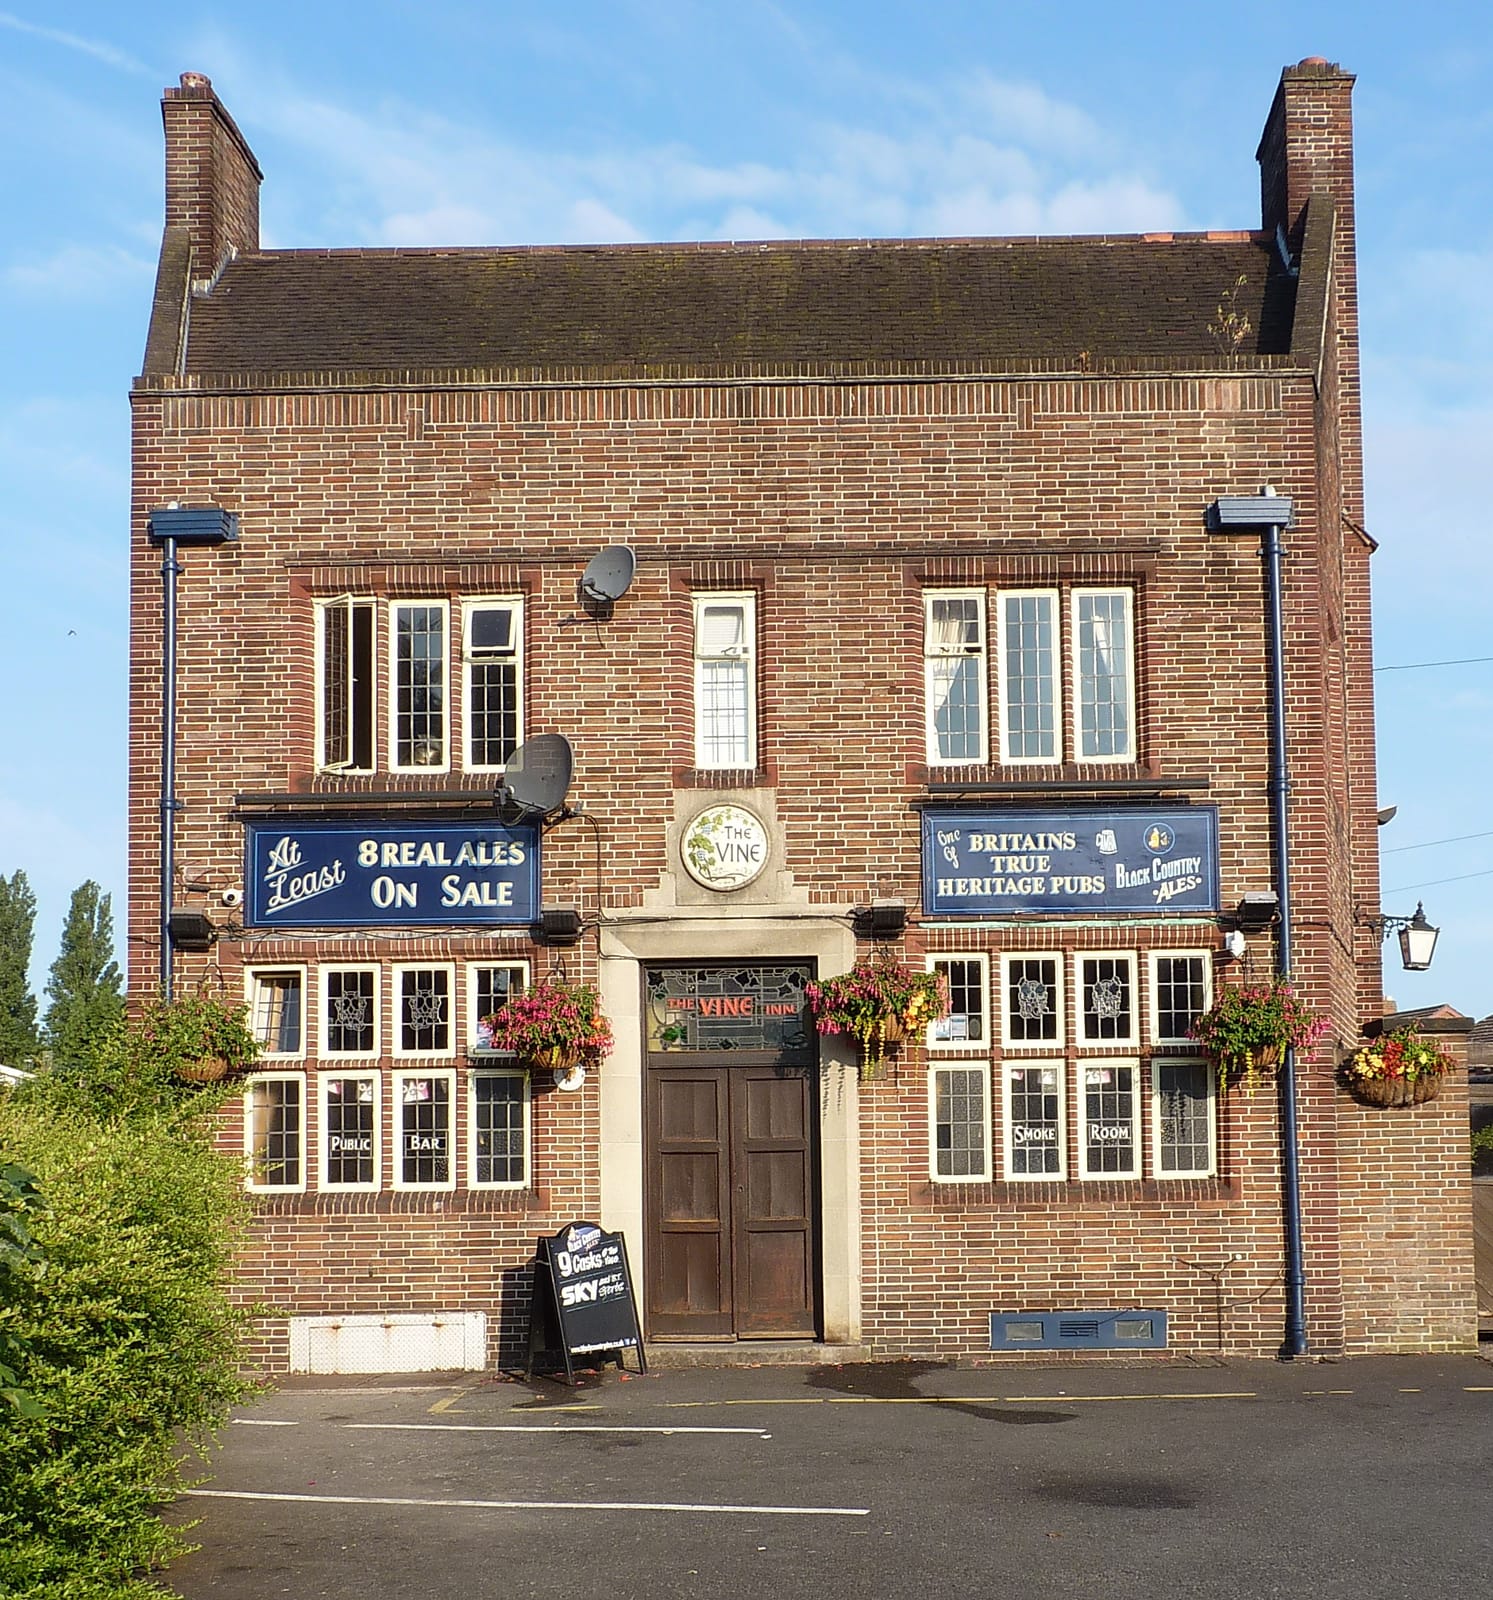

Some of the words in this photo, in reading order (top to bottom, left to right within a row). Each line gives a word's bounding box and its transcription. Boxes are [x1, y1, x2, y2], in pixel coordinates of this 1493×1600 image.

[723, 825, 752, 839] THE
[937, 829, 961, 847] One
[267, 836, 302, 873] At
[357, 839, 380, 868] 8
[380, 841, 452, 868] REAL
[453, 840, 526, 867] ALES
[715, 842, 761, 863] VINE
[989, 854, 1052, 874] TRUE
[267, 859, 346, 908] Least
[936, 876, 1046, 897] HERITAGE
[1049, 875, 1106, 895] PUBS
[1155, 875, 1197, 905] ALES
[667, 997, 695, 1010] THE
[699, 996, 754, 1017] VINE
[765, 1003, 798, 1016] INN
[557, 1251, 573, 1278] 9
[572, 1251, 603, 1274] Casks
[561, 1279, 599, 1307] SKY
